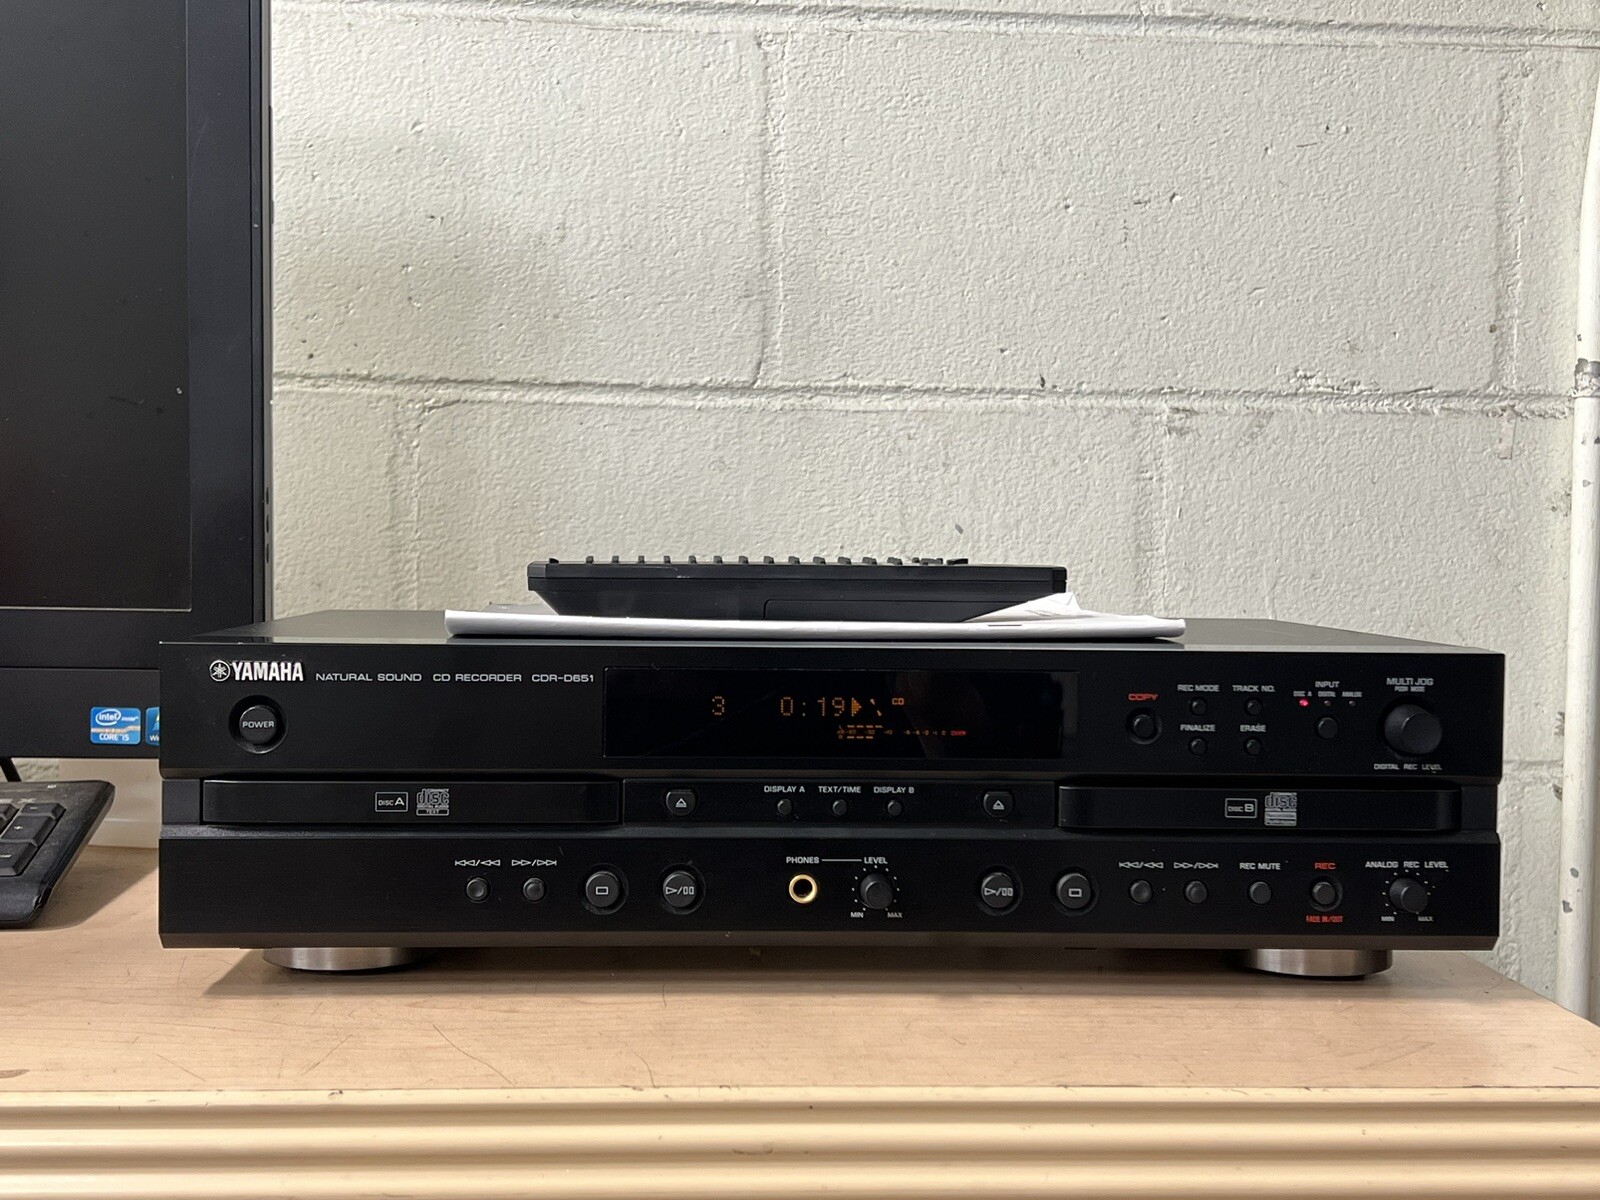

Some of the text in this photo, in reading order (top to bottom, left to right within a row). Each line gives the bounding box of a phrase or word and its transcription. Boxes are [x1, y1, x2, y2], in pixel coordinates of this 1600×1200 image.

[232, 661, 304, 682] YAMAHA
[315, 673, 594, 683] NATURAL SOUND CD RECORDER CDR-D651
[1386, 677, 1434, 686] MULTI JOG
[1177, 684, 1220, 692] REC MODE
[1128, 693, 1158, 701] COPY
[711, 695, 725, 716] 3
[780, 696, 845, 717] 0:19
[242, 721, 275, 729] POWER
[1180, 724, 1216, 732] FINALIZE
[1240, 724, 1266, 732] ERASE
[763, 785, 806, 793] DISPLAY A
[818, 785, 862, 794] TEXT/TIME
[873, 786, 915, 794] DISPLAY B
[394, 797, 405, 806] A
[1244, 803, 1254, 812] B
[786, 856, 888, 864] PHONES LEVEL
[1239, 862, 1281, 870] REC MUTE
[1314, 862, 1337, 870] REC
